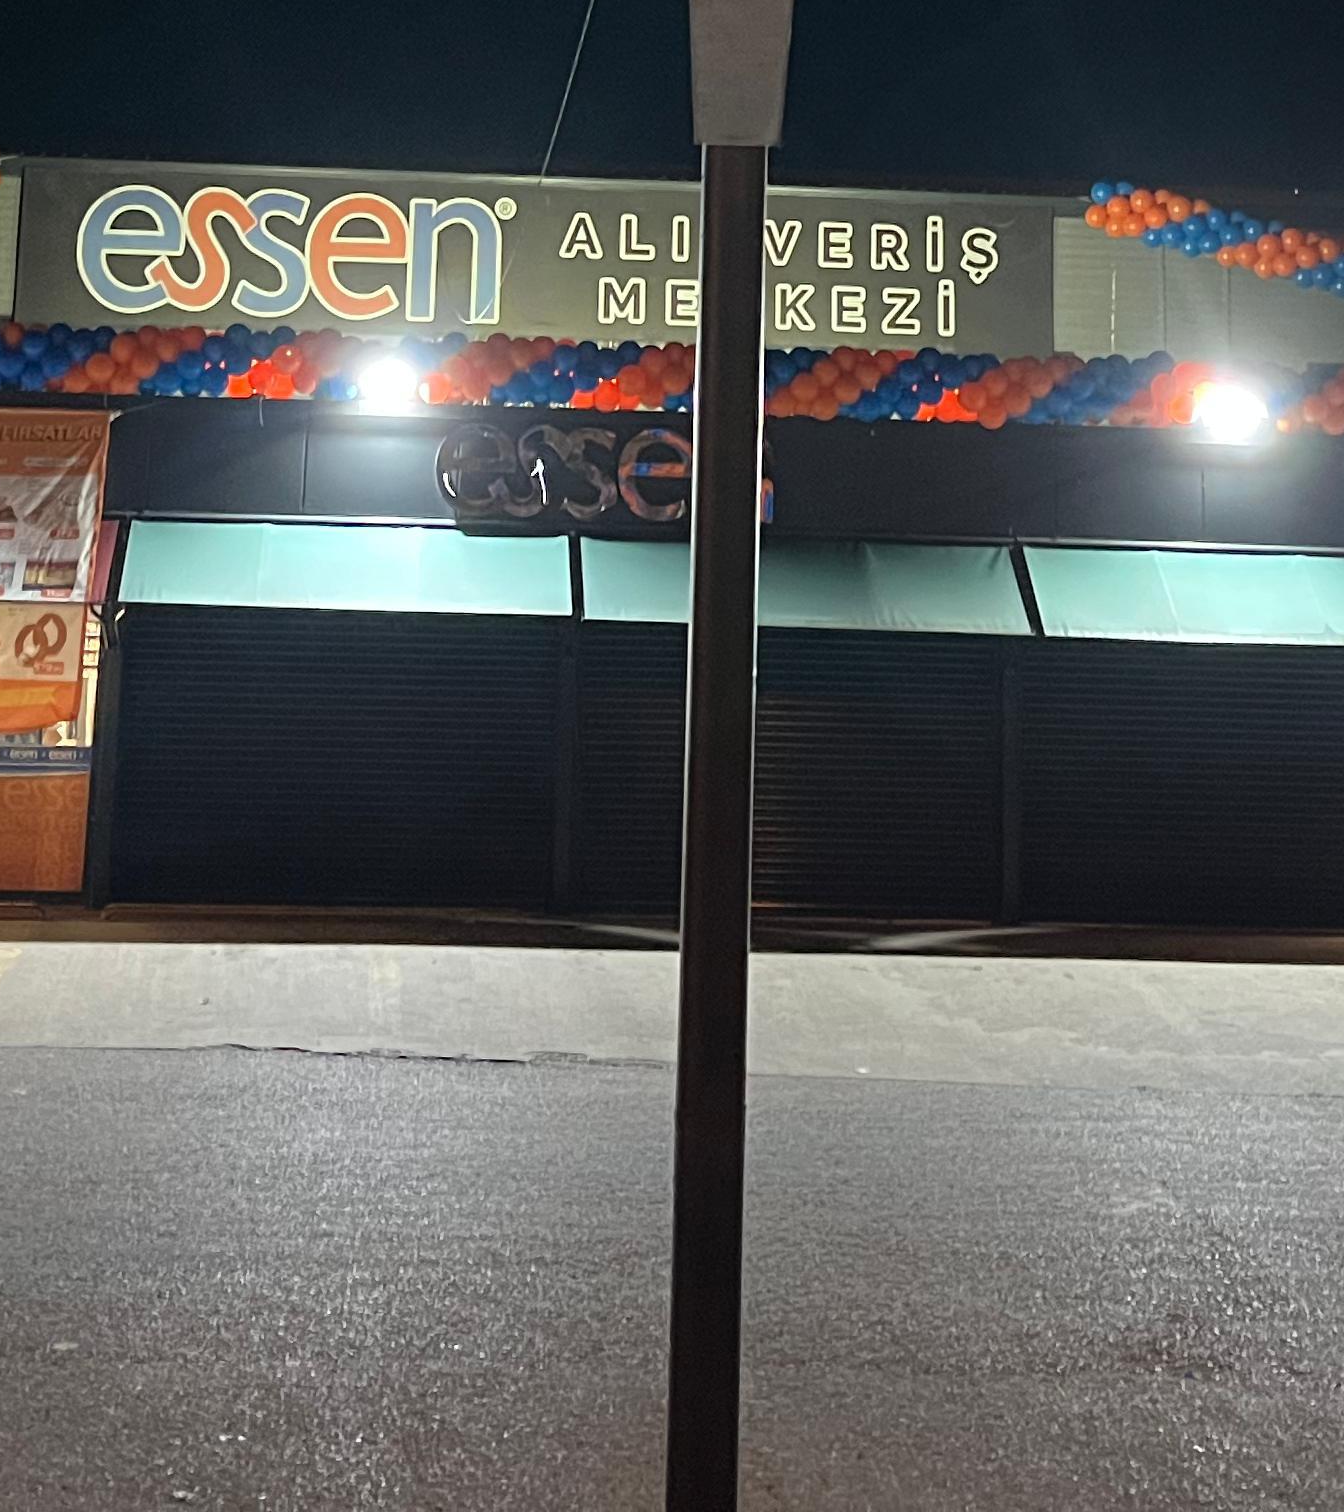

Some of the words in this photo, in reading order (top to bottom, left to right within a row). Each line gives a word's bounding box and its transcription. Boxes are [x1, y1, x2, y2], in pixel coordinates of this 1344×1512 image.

[76, 184, 502, 324] essen
[559, 212, 999, 285] ALIVERİŞ
[598, 277, 956, 337] MEKEZİ
[434, 422, 775, 524] esse
